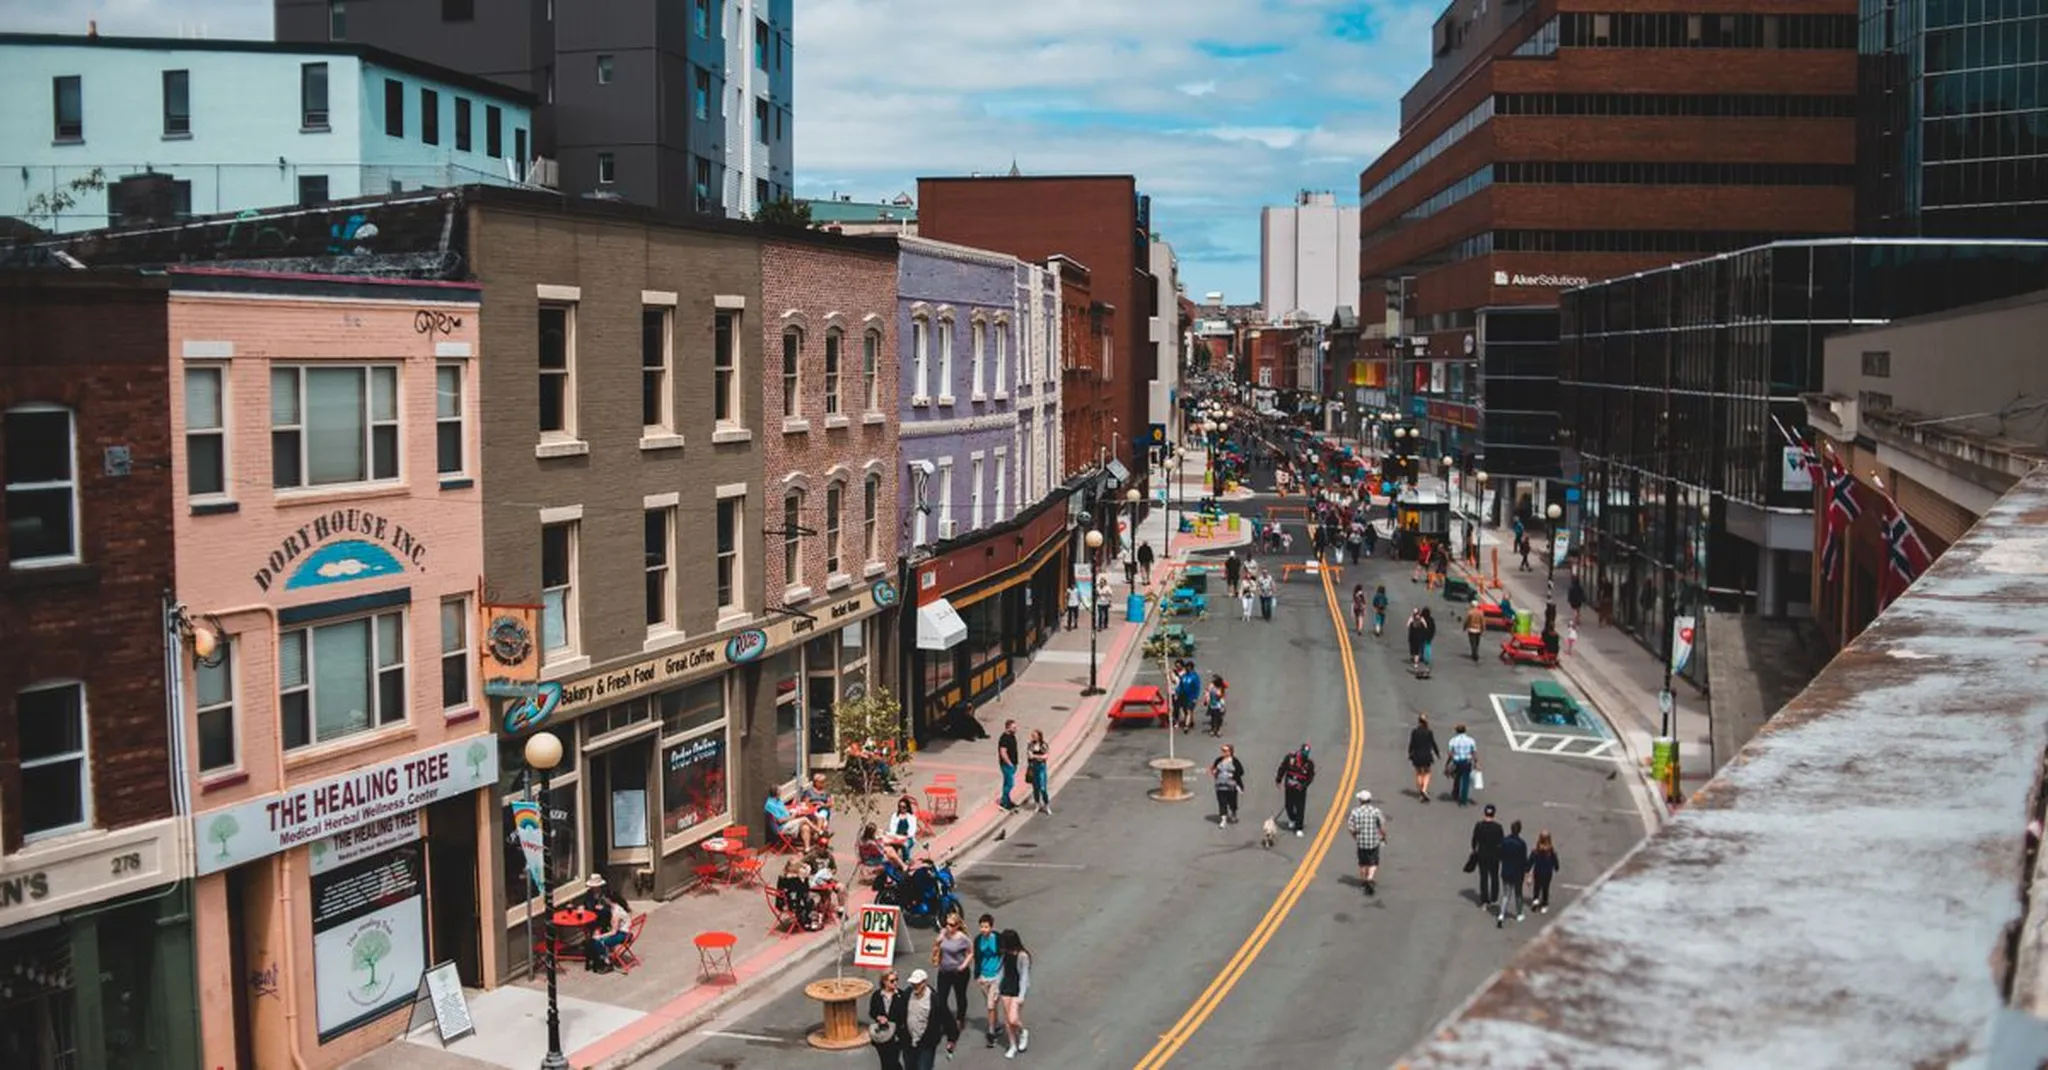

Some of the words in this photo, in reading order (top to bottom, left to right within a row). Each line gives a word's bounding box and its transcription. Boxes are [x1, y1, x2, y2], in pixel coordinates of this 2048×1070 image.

[253, 508, 388, 594] DORYHOUSE
[392, 525, 428, 573] INC.
[561, 683, 594, 706] Bakery
[597, 680, 605, 695] &
[606, 669, 631, 692] Fresh
[634, 663, 656, 684] Food
[665, 656, 688, 675] Great
[689, 648, 716, 667] Coffee
[266, 793, 307, 832] THE
[314, 767, 398, 818] HEALING
[404, 752, 450, 788] TREE
[280, 826, 322, 846] Medical
[324, 811, 360, 831] Herbal
[362, 798, 405, 820] Wellness
[407, 786, 439, 804] Center
[333, 834, 353, 851] THE
[353, 818, 394, 846] HEALING
[395, 810, 417, 830] TREE
[110, 853, 141, 875] 278
[0, 872, 49, 908] N'S
[863, 910, 895, 932] OPEN
